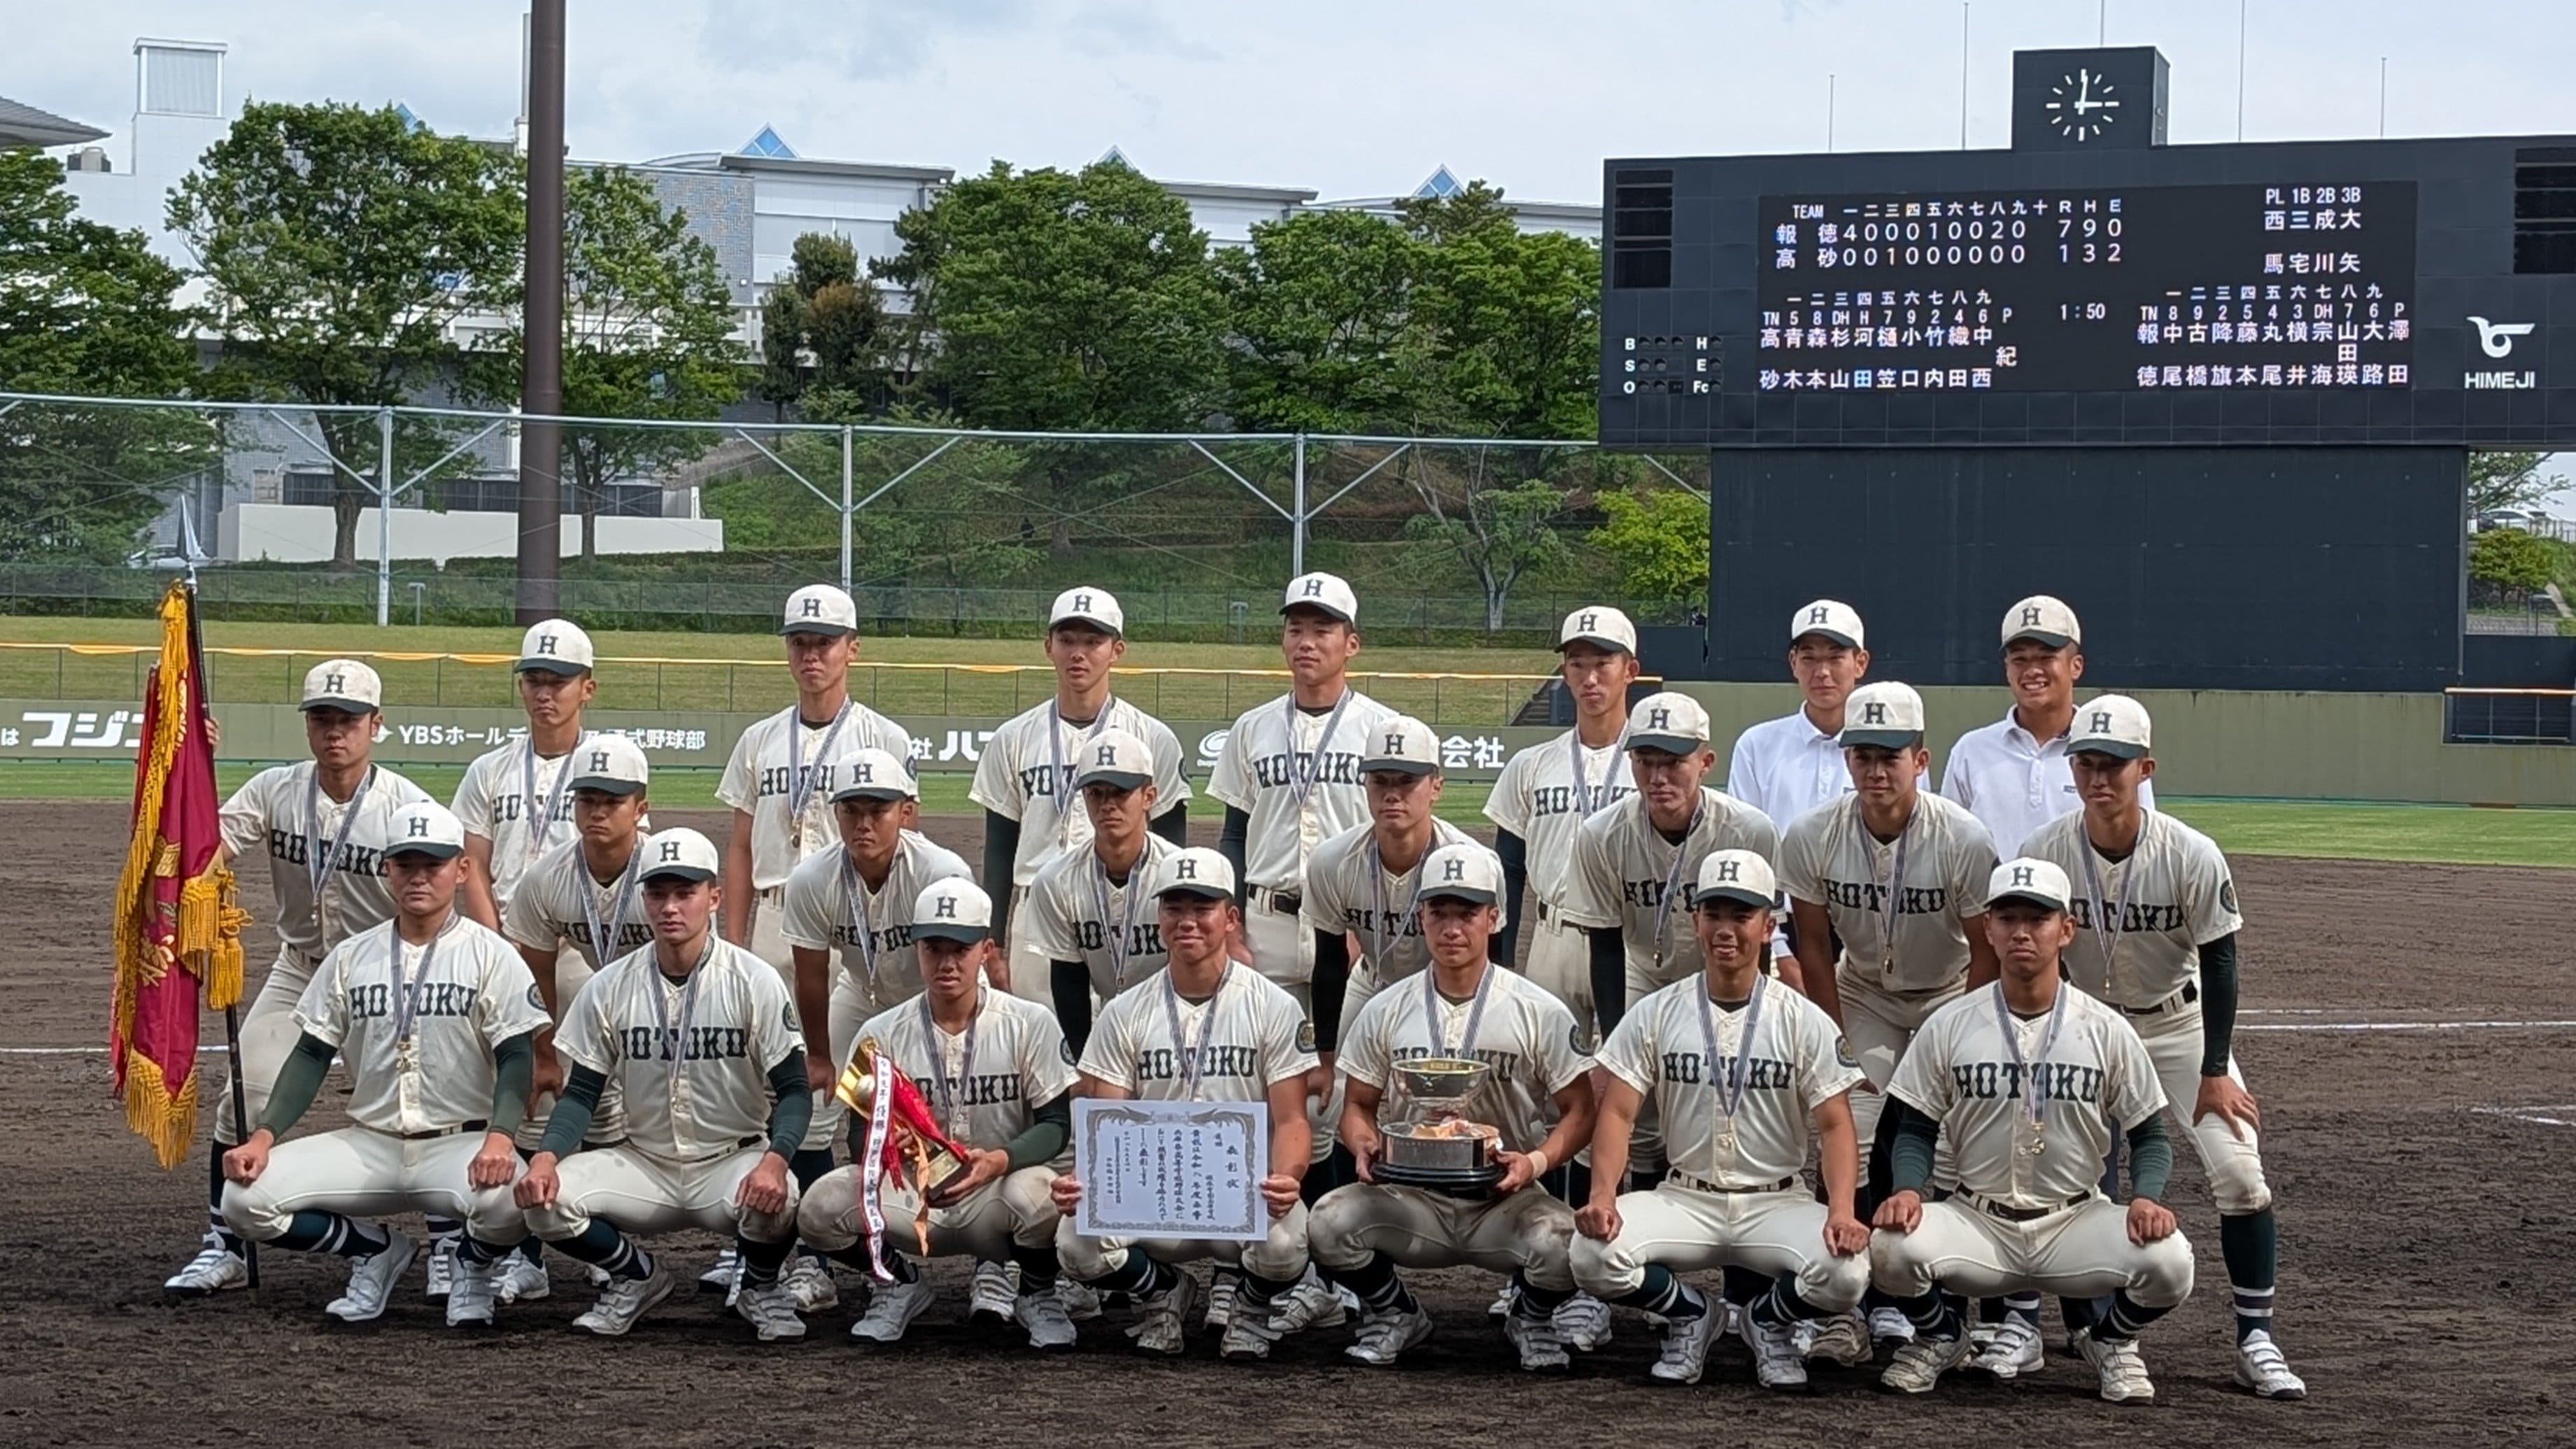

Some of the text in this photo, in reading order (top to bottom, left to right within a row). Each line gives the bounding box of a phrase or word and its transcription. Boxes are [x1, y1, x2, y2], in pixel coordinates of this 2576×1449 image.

[2266, 187, 2361, 204] PL 1B 2B 3B
[1793, 205, 1823, 219] TEAM
[2060, 201, 2071, 213] R
[2084, 200, 2096, 213] H
[2109, 199, 2121, 212] E
[1843, 224, 1857, 241] 4
[1864, 223, 1878, 241] 0
[1885, 223, 1898, 241] 0
[1906, 223, 1919, 241] 0
[1930, 222, 1937, 239] 1
[1948, 222, 1962, 239] 0
[1969, 221, 1983, 239] 0
[1991, 220, 2004, 239] 2
[2012, 220, 2025, 239] 0
[2059, 220, 2071, 237] 7
[2083, 219, 2096, 237] 9
[2108, 218, 2121, 236] 0
[1843, 248, 1856, 266] 0
[1864, 248, 1877, 266] 0
[1888, 248, 1894, 264] 1
[1906, 247, 1918, 264] 0
[1927, 247, 1940, 264] 0
[1948, 246, 1961, 264] 0
[1969, 246, 1982, 264] 0
[1990, 245, 2003, 263] 0
[2011, 245, 2025, 263] 0
[2060, 244, 2067, 262] 1
[2083, 243, 2095, 262] 3
[2108, 243, 2120, 261] 2
[1763, 308, 2012, 326] TN 5 8 DH H 7 9 2 4 6 P
[2061, 303, 2105, 320] 1:50
[2141, 302, 2405, 320] TN 8 9 2 5 4 3 DH 7 6 P
[1625, 338, 1635, 350] B
[1697, 337, 1707, 350] H
[1625, 360, 1635, 372] S
[1697, 359, 1706, 372] E
[1624, 381, 1635, 393] O
[1694, 381, 1708, 393] Fc
[2465, 372, 2535, 388] HIMEJI
[1302, 579, 1324, 598] H
[802, 599, 821, 617] H
[1073, 595, 1093, 613] H
[1577, 614, 1598, 632] H
[1808, 607, 1829, 625] H
[2021, 607, 2041, 627] H
[537, 636, 558, 655] H
[324, 674, 346, 694] H
[1648, 709, 1671, 730] H
[1864, 702, 1886, 724] H
[2089, 712, 2112, 733] H
[1384, 734, 1405, 755] H
[589, 752, 610, 772] H
[1096, 746, 1117, 766] H
[853, 763, 874, 784] H
[407, 817, 428, 837] H
[660, 842, 681, 862] H
[1176, 859, 1198, 879] H
[1443, 859, 1465, 880] H
[1717, 861, 1741, 882] H
[2011, 867, 2034, 887] H
[935, 897, 957, 917] H
[2069, 898, 2187, 933] OTOKU
